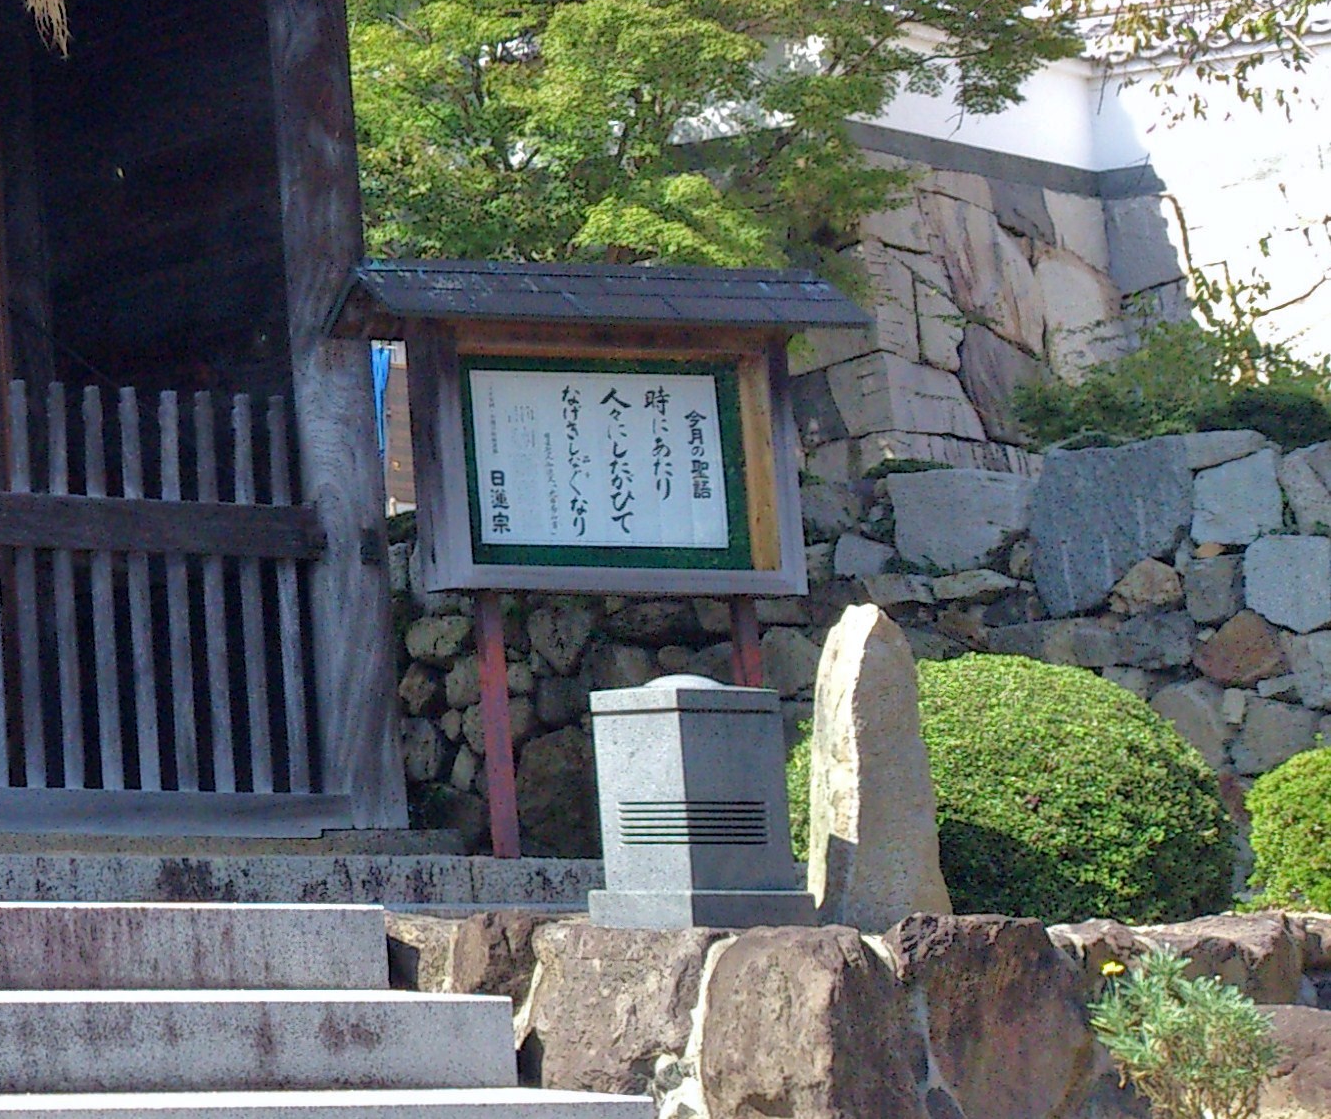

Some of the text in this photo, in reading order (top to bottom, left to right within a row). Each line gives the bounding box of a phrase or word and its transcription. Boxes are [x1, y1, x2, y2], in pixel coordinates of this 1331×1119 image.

[599, 387, 635, 534] 人々にしたがひて
[643, 385, 674, 501] 時にあたり
[489, 469, 512, 535] 日蓮宗
